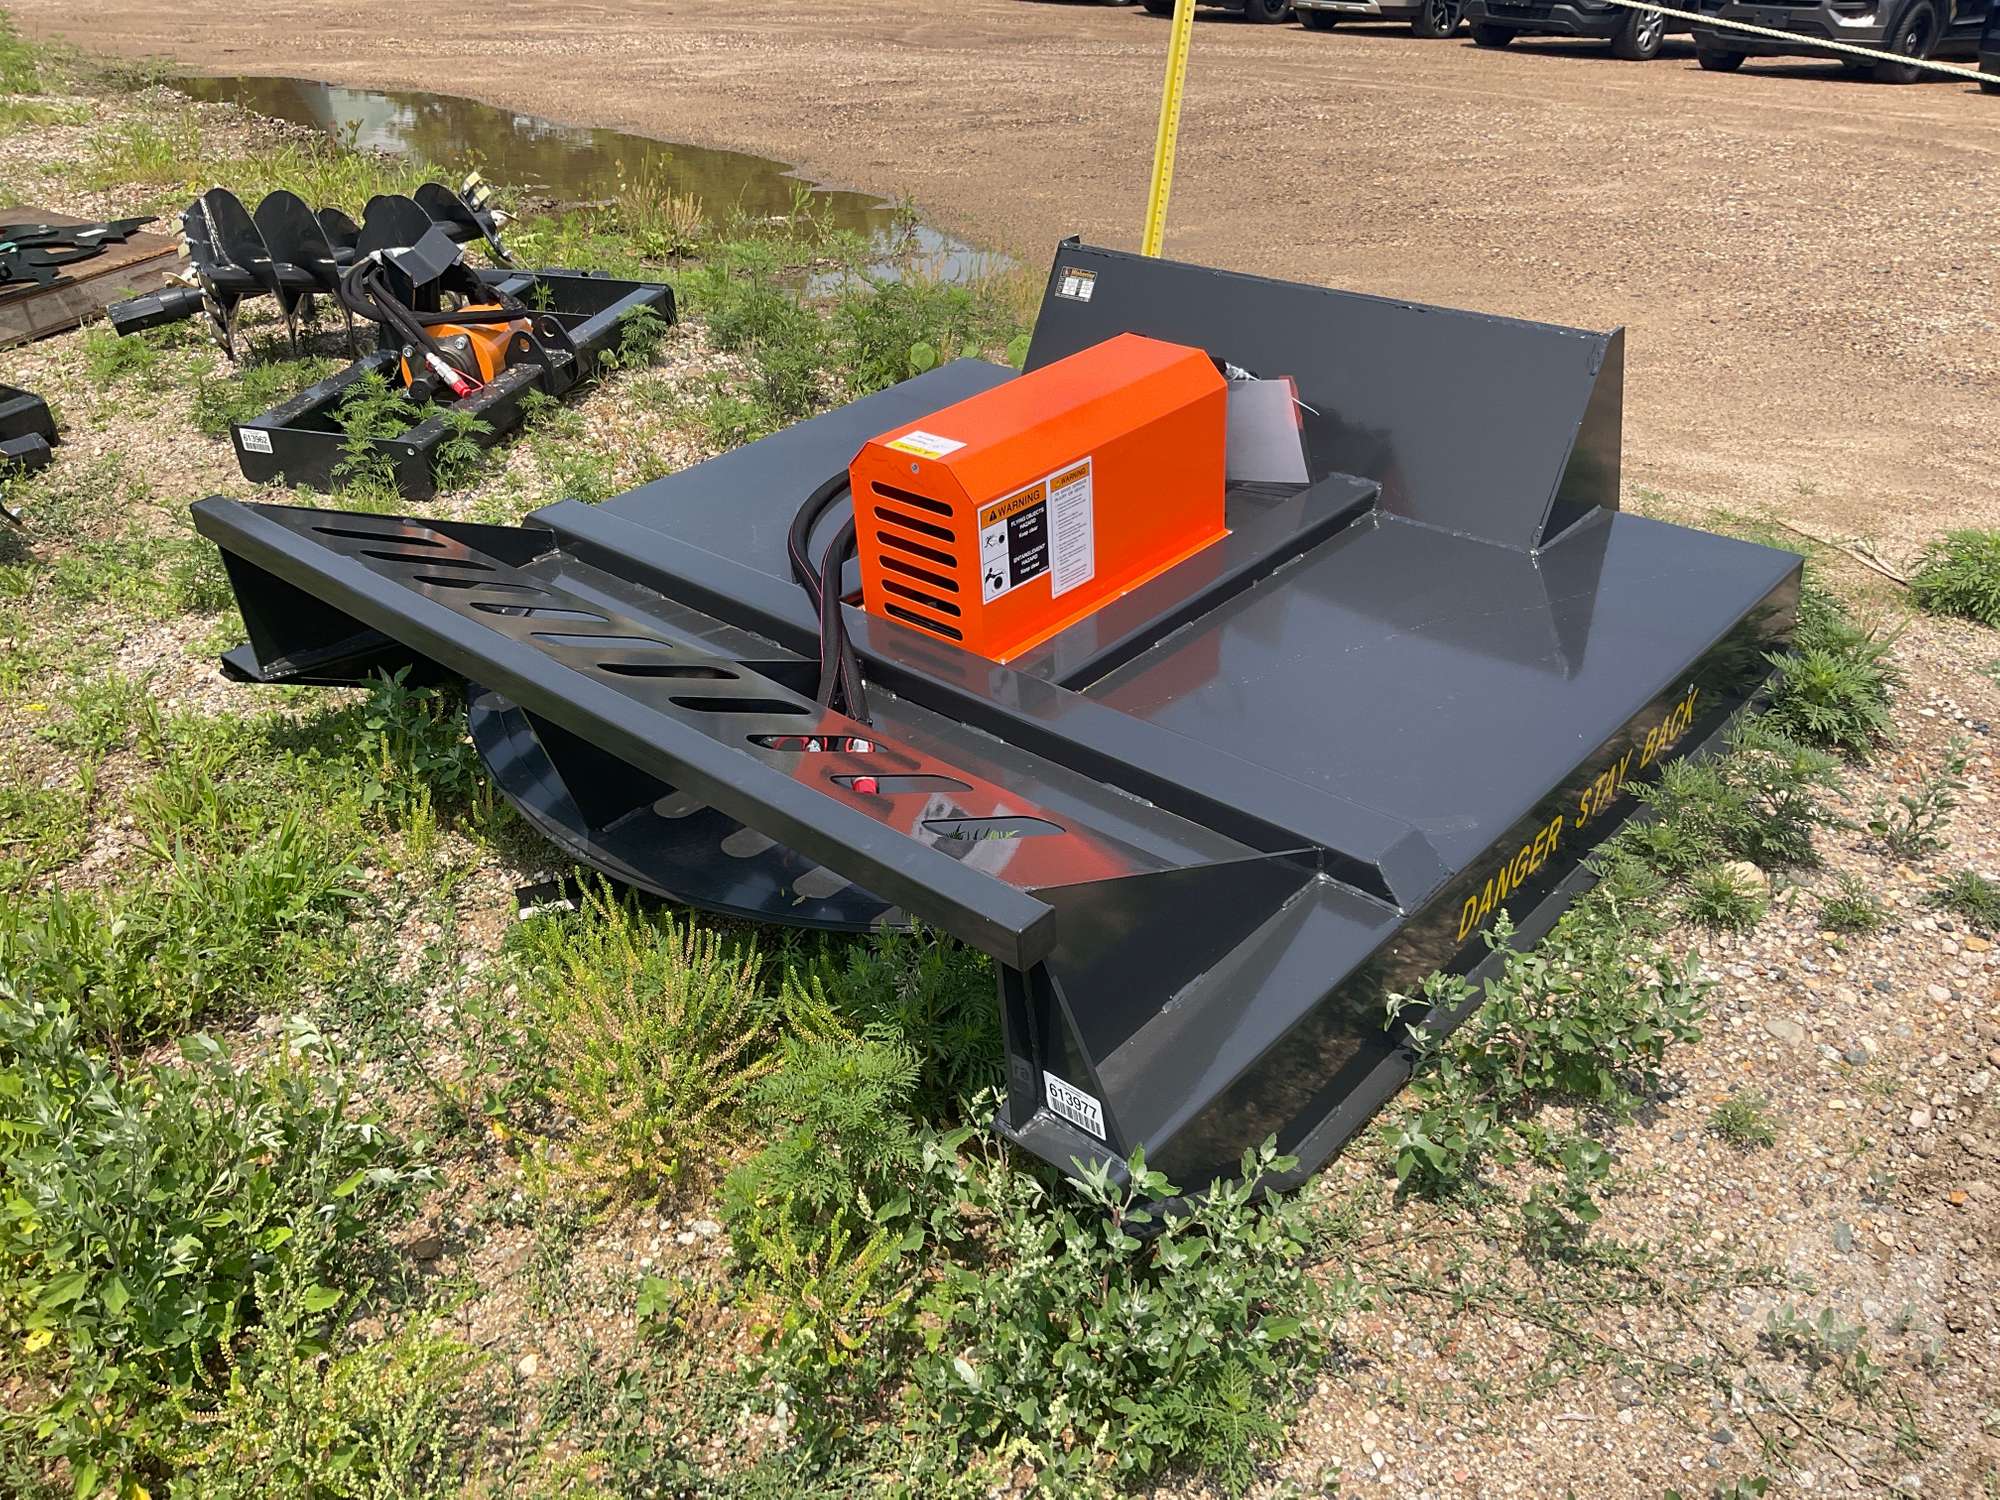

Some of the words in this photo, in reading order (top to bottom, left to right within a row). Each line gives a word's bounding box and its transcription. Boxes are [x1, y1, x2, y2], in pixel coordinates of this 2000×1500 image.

[1061, 467, 1086, 485] WARNING
[997, 490, 1040, 517] WARNING
[1026, 507, 1044, 520] OBJECTS
[1020, 517, 1036, 529] HAZARD
[1021, 553, 1038, 565] HAZARD
[1456, 814, 1563, 942] DANGER
[1576, 748, 1633, 829] STAY
[1639, 687, 1700, 769] BACK
[1049, 1082, 1097, 1119] 613977
